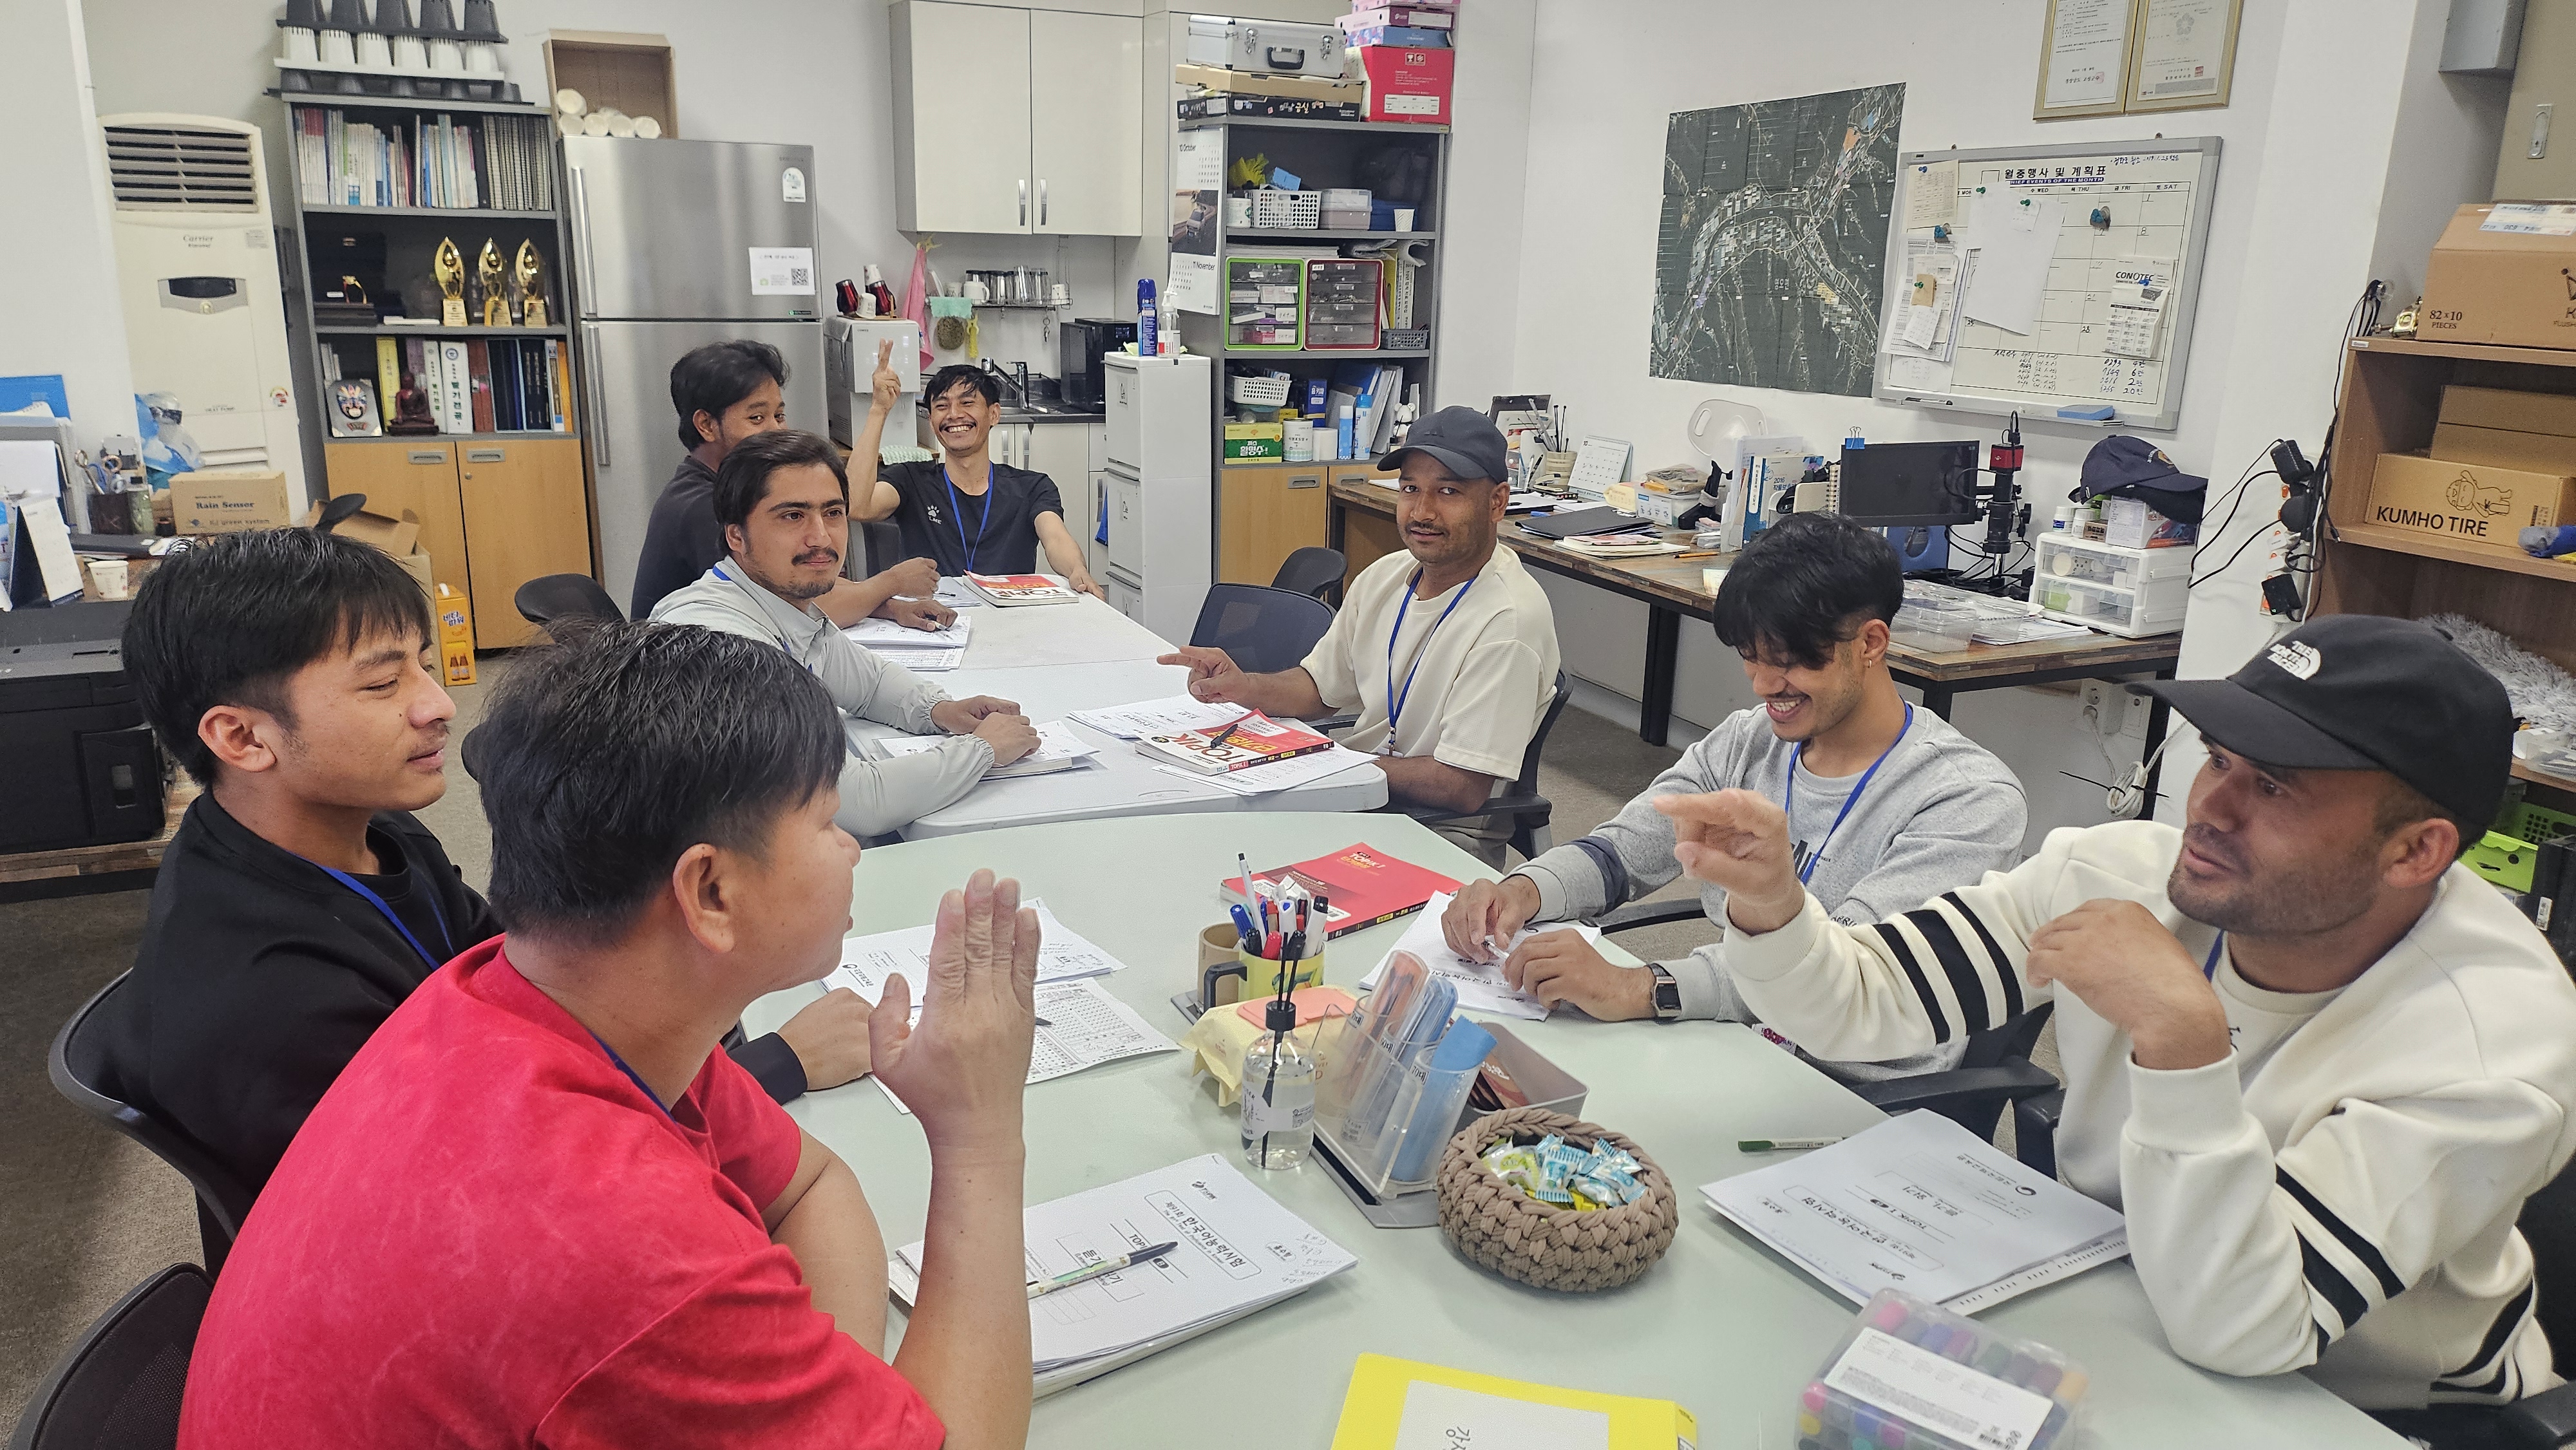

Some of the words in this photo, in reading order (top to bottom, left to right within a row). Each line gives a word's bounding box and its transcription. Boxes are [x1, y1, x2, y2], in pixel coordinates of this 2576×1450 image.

[1183, 142, 1197, 152] October
[2004, 167, 2049, 180] 월중행사
[2054, 167, 2065, 178] 및
[2071, 165, 2107, 176] 계획표
[1196, 260, 1216, 271] November
[2115, 271, 2155, 282] CONOTEC
[2431, 321, 2458, 330] PIECES
[1240, 446, 1265, 457] 활명수
[2376, 505, 2444, 530] KUMHO
[2448, 516, 2489, 537] TIRE
[995, 588, 1066, 597] TOPIK
[2269, 643, 2303, 664] NORTH
[2292, 640, 2313, 657] THE
[2267, 652, 2300, 671] FACE
[1162, 733, 1247, 762] TOPIK
[1230, 761, 1244, 770] TOPIK
[1349, 852, 1380, 867] TOPIK
[1412, 1066, 1427, 1082] 70대
[1801, 1197, 1888, 1244] 한국어능력시험
[1899, 1212, 1927, 1230] TOPIK
[1129, 1233, 1148, 1252] TOPI
[1165, 1201, 1186, 1218] 제91회
[1182, 1216, 1246, 1269] 한국어능력시험
[1189, 1232, 1208, 1255] Proficiency
